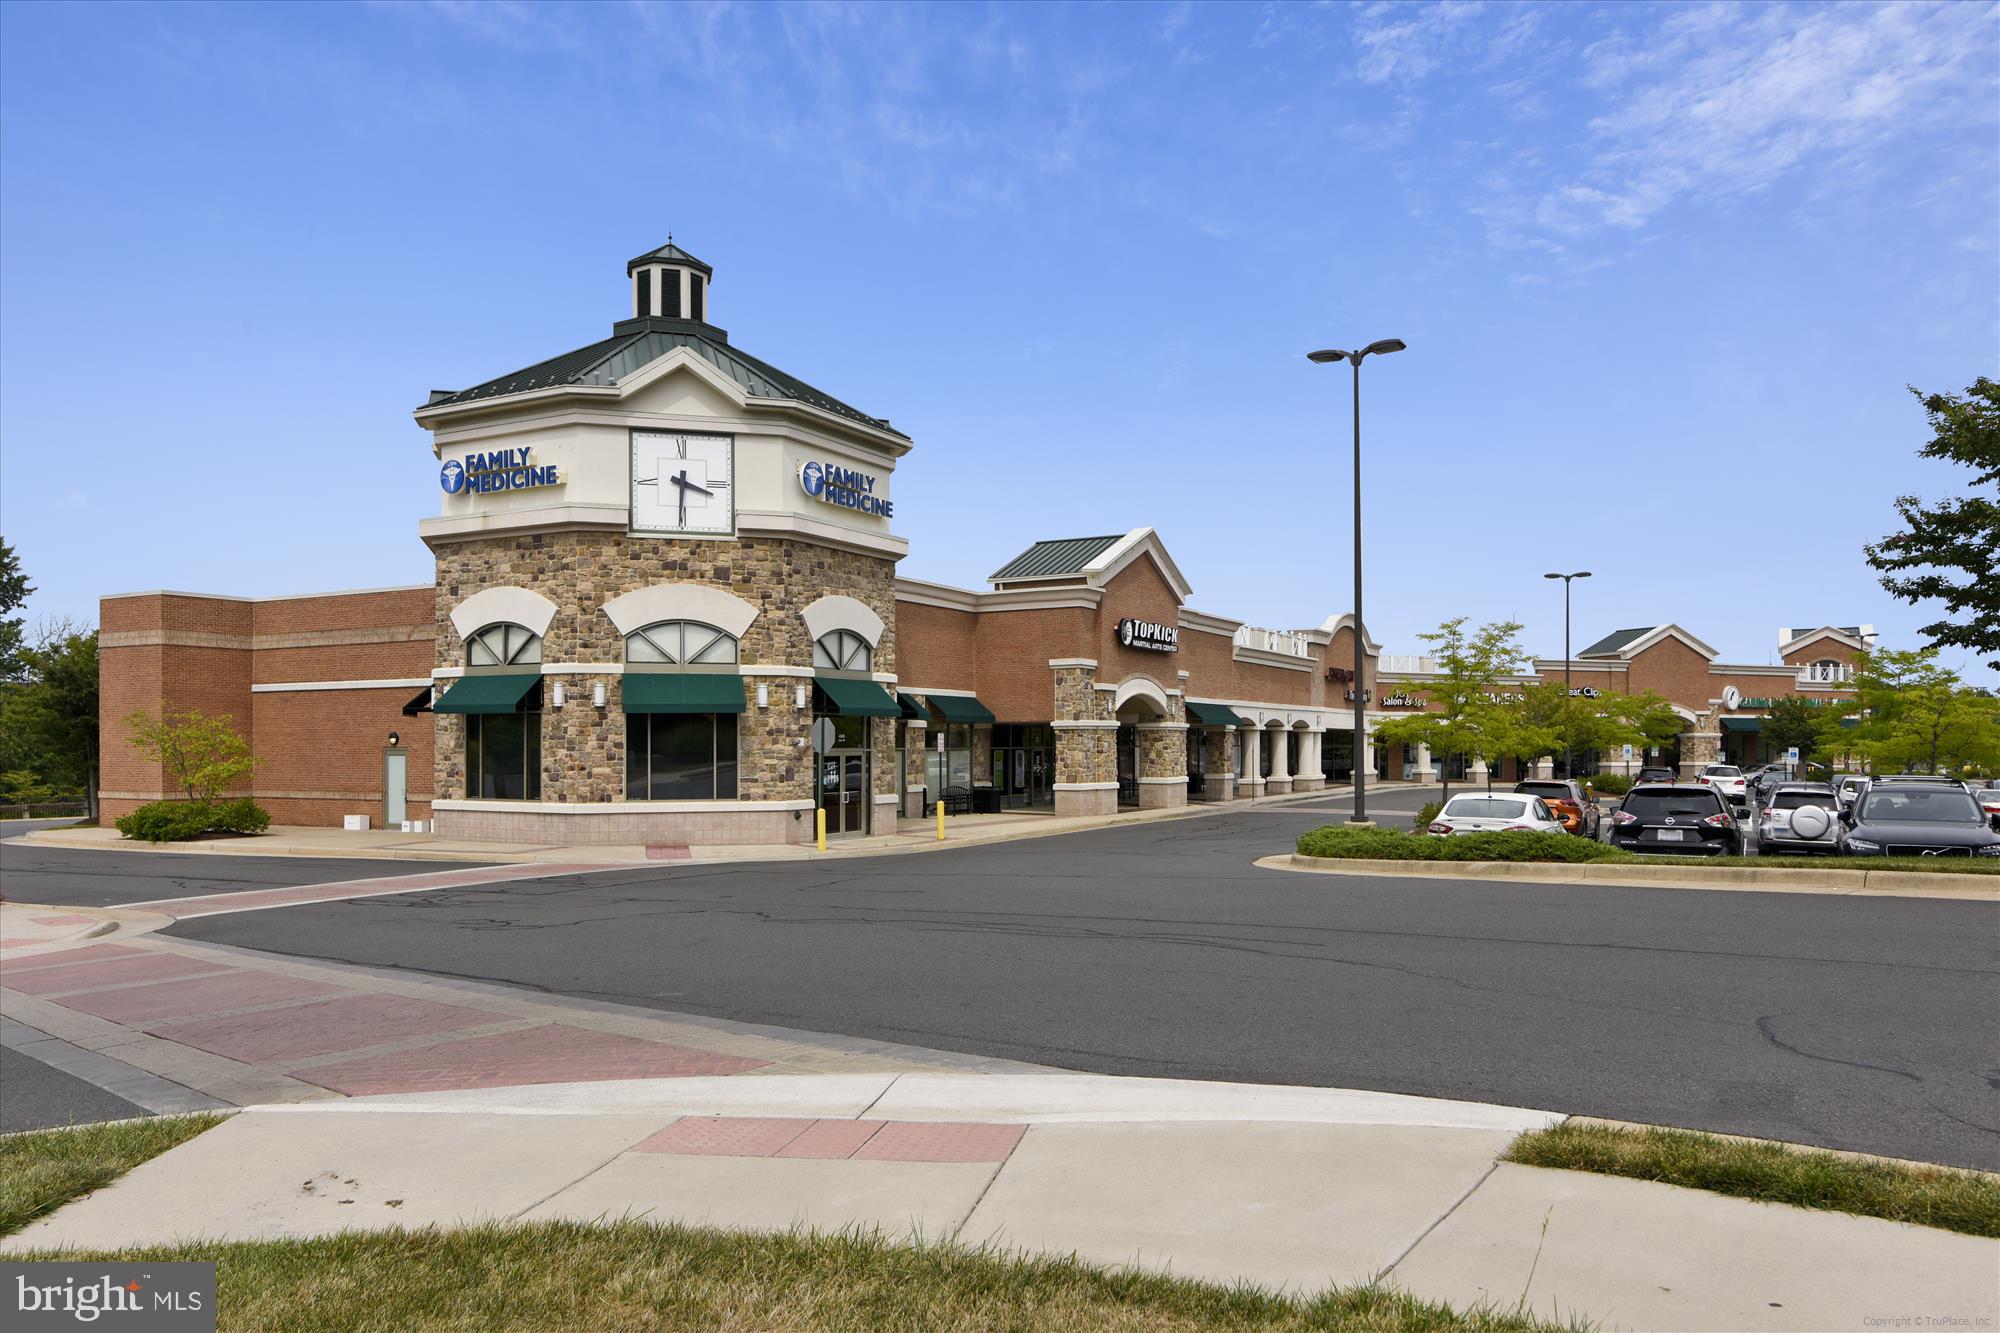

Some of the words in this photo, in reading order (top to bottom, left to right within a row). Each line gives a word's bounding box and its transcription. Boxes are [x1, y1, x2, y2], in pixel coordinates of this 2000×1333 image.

[465, 447, 531, 473] FAMILY
[465, 465, 557, 494] MEDICINE
[825, 463, 876, 493] FAMILY
[825, 484, 894, 518] MEDICINE
[1132, 639, 1152, 649] MARTIAL
[1152, 643, 1163, 651] ARTS
[1163, 644, 1178, 652] CENTER
[1383, 696, 1403, 706] Salon
[1404, 697, 1412, 706] &
[1414, 697, 1427, 707] Spa
